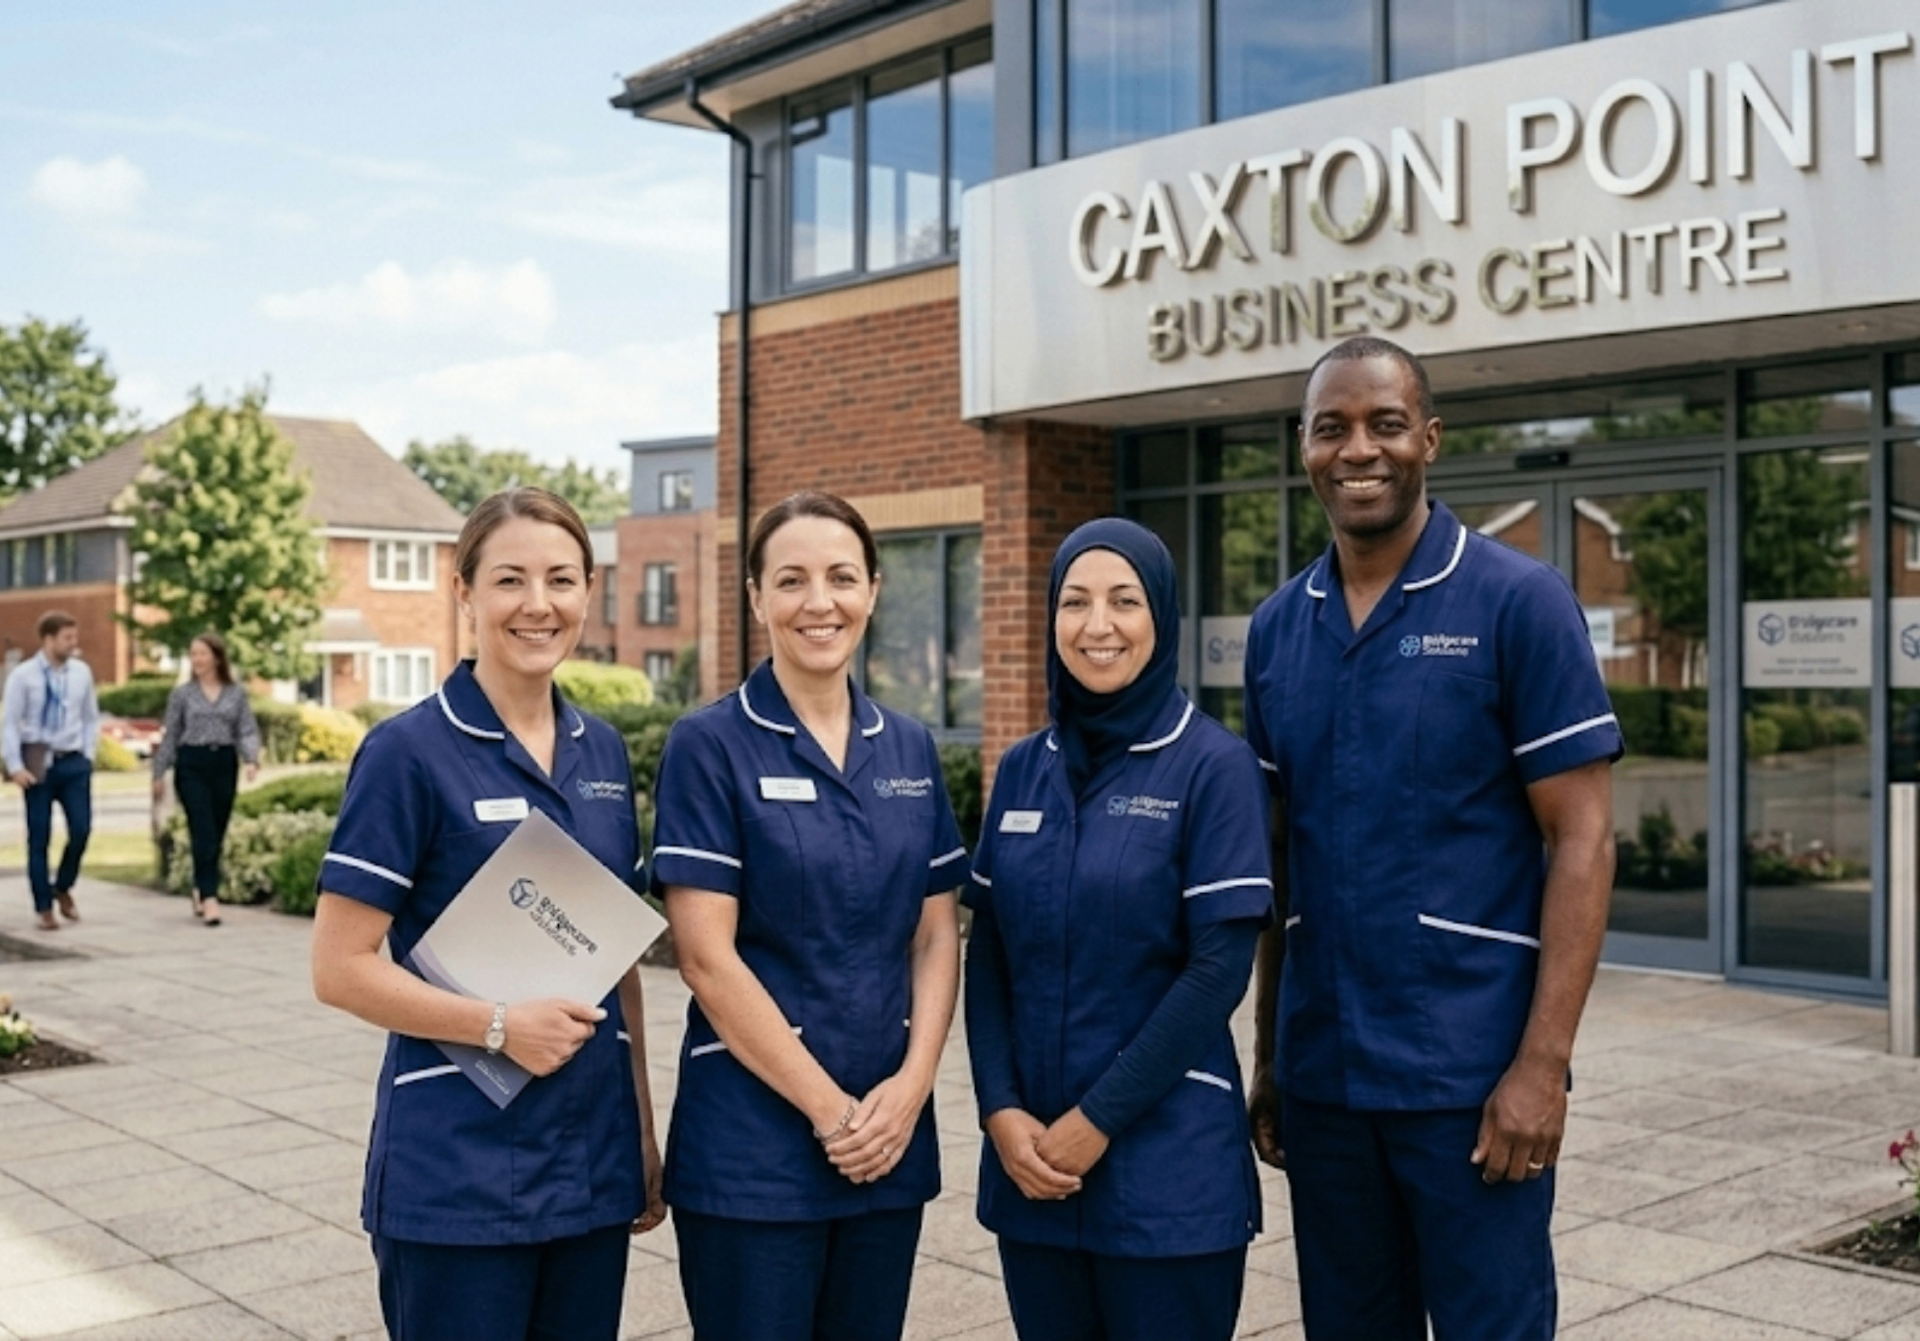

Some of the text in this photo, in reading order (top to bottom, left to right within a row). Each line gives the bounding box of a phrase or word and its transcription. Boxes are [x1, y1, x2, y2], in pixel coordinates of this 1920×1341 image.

[1069, 31, 1912, 290] CAXTON POINT
[1148, 207, 1787, 362] BUSINESS CENTRE
